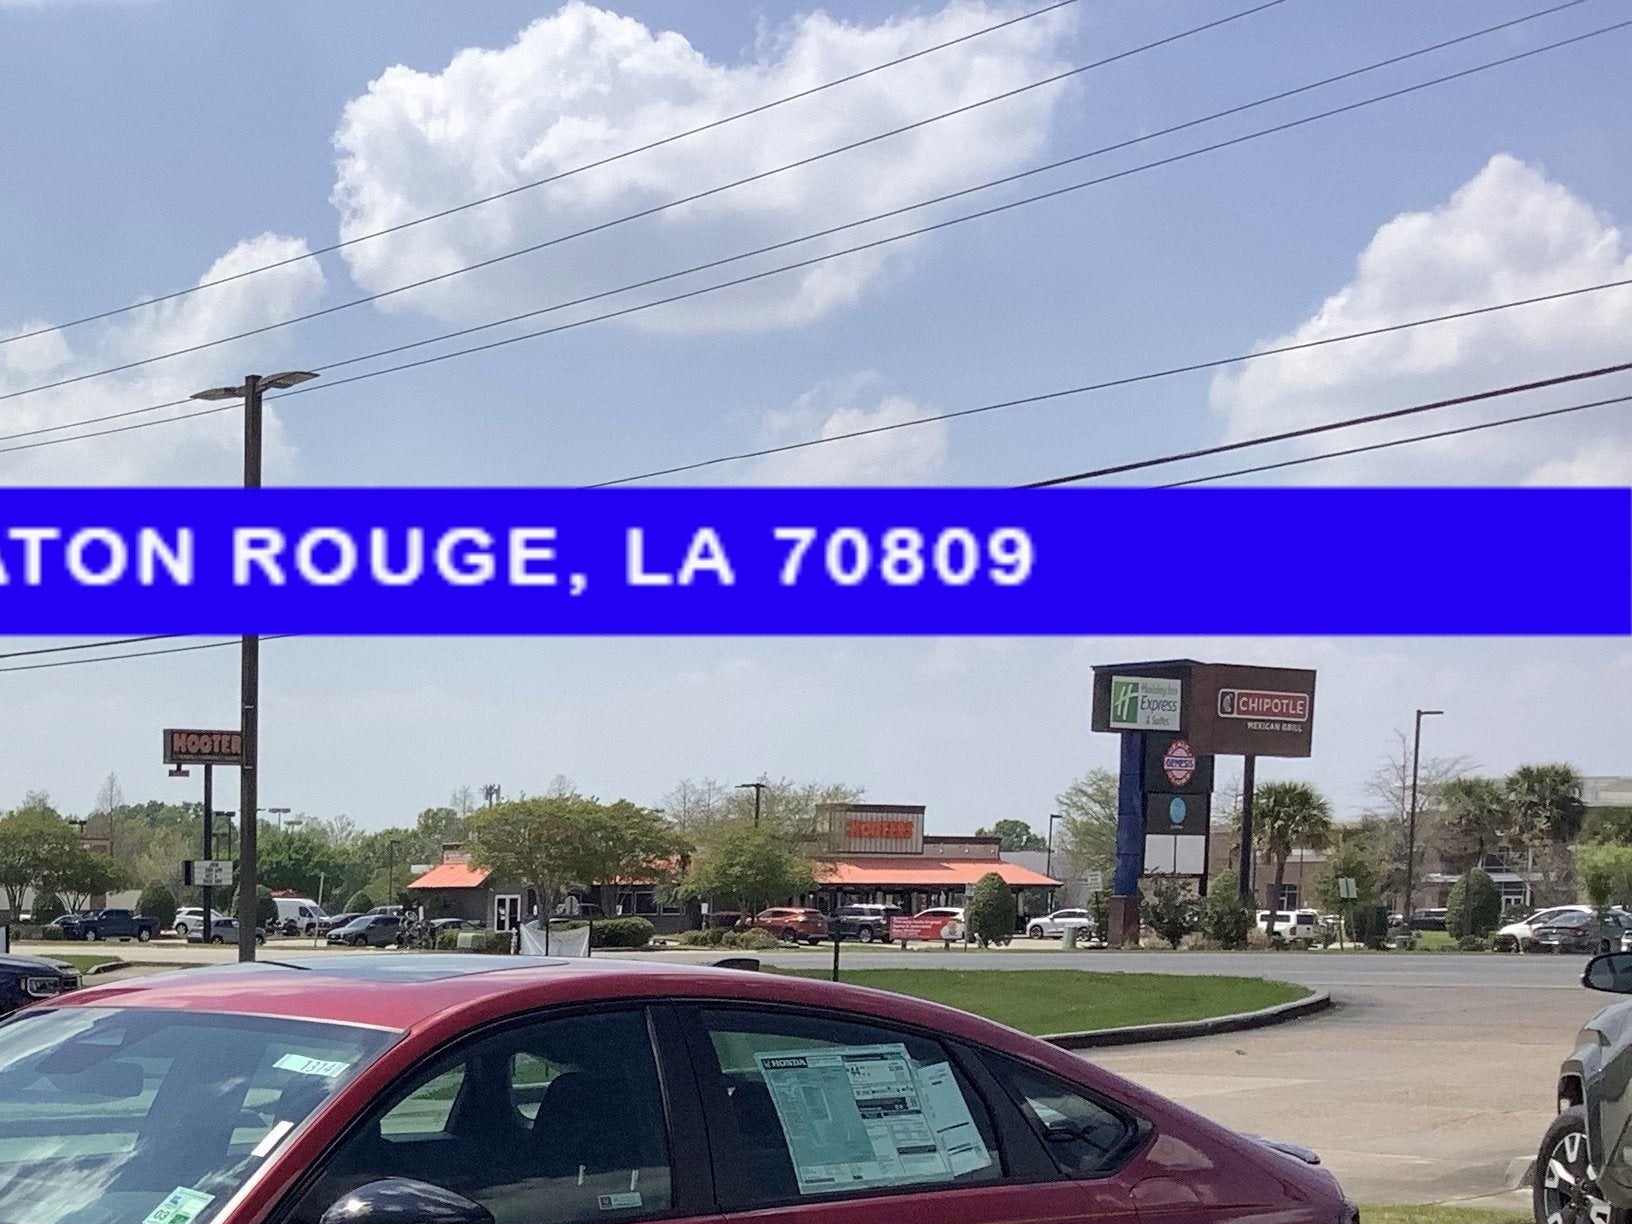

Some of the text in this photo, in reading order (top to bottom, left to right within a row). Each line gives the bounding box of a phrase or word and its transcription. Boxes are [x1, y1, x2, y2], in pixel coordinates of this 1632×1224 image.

[1141, 695, 1178, 714] Express
[1239, 696, 1304, 715] CHIPOTLE
[1247, 721, 1303, 733] MEXICAN GRILL
[172, 733, 241, 754] HOOTER
[300, 1060, 336, 1073] 1314
[771, 1058, 807, 1068] HONDA
